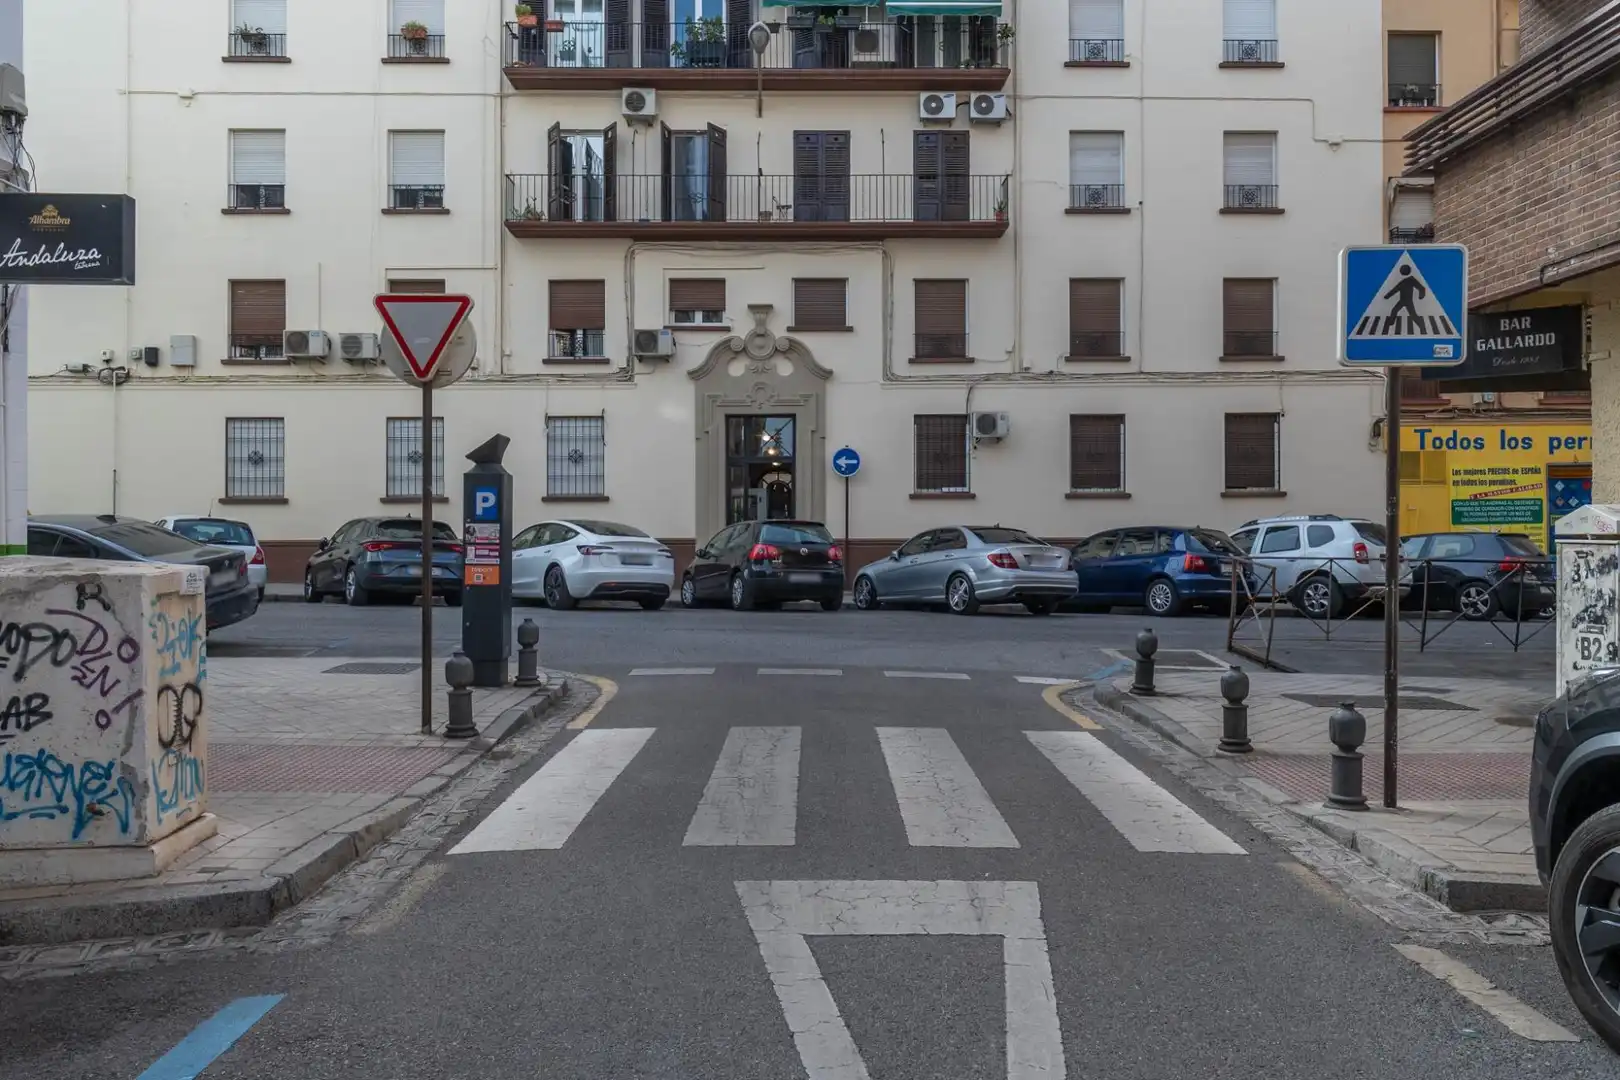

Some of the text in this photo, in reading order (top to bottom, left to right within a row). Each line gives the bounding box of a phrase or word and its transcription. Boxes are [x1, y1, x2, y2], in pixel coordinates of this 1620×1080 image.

[28, 214, 71, 225] Alhambra
[0, 237, 102, 268] Andaluza
[1500, 316, 1531, 331] BAR
[1476, 332, 1556, 351] GALLARDO
[1413, 428, 1485, 451] Todos
[1500, 429, 1533, 451] los
[1452, 468, 1461, 476] Los
[1462, 468, 1486, 477] mejores
[1487, 467, 1511, 475] PRECIOS
[476, 491, 496, 516] P
